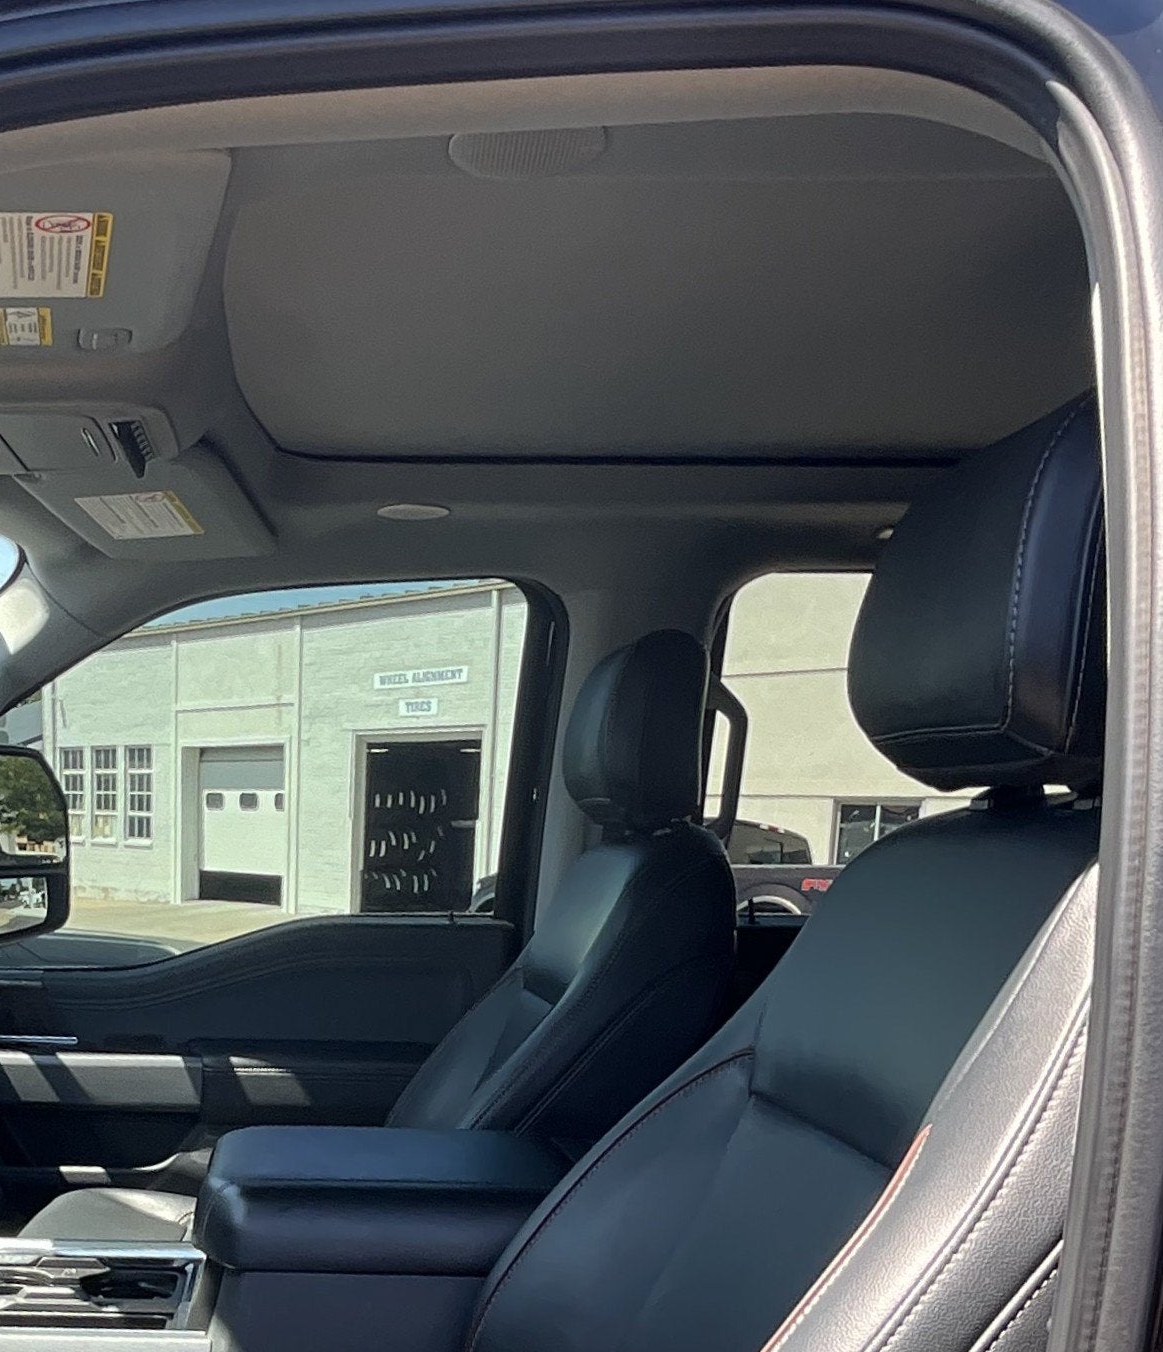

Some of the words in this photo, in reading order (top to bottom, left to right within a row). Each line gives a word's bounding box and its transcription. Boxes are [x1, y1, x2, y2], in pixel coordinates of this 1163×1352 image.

[378, 673, 409, 686] WHEEL
[411, 668, 464, 683] ALIGNMENT
[404, 700, 432, 714] TIRES
